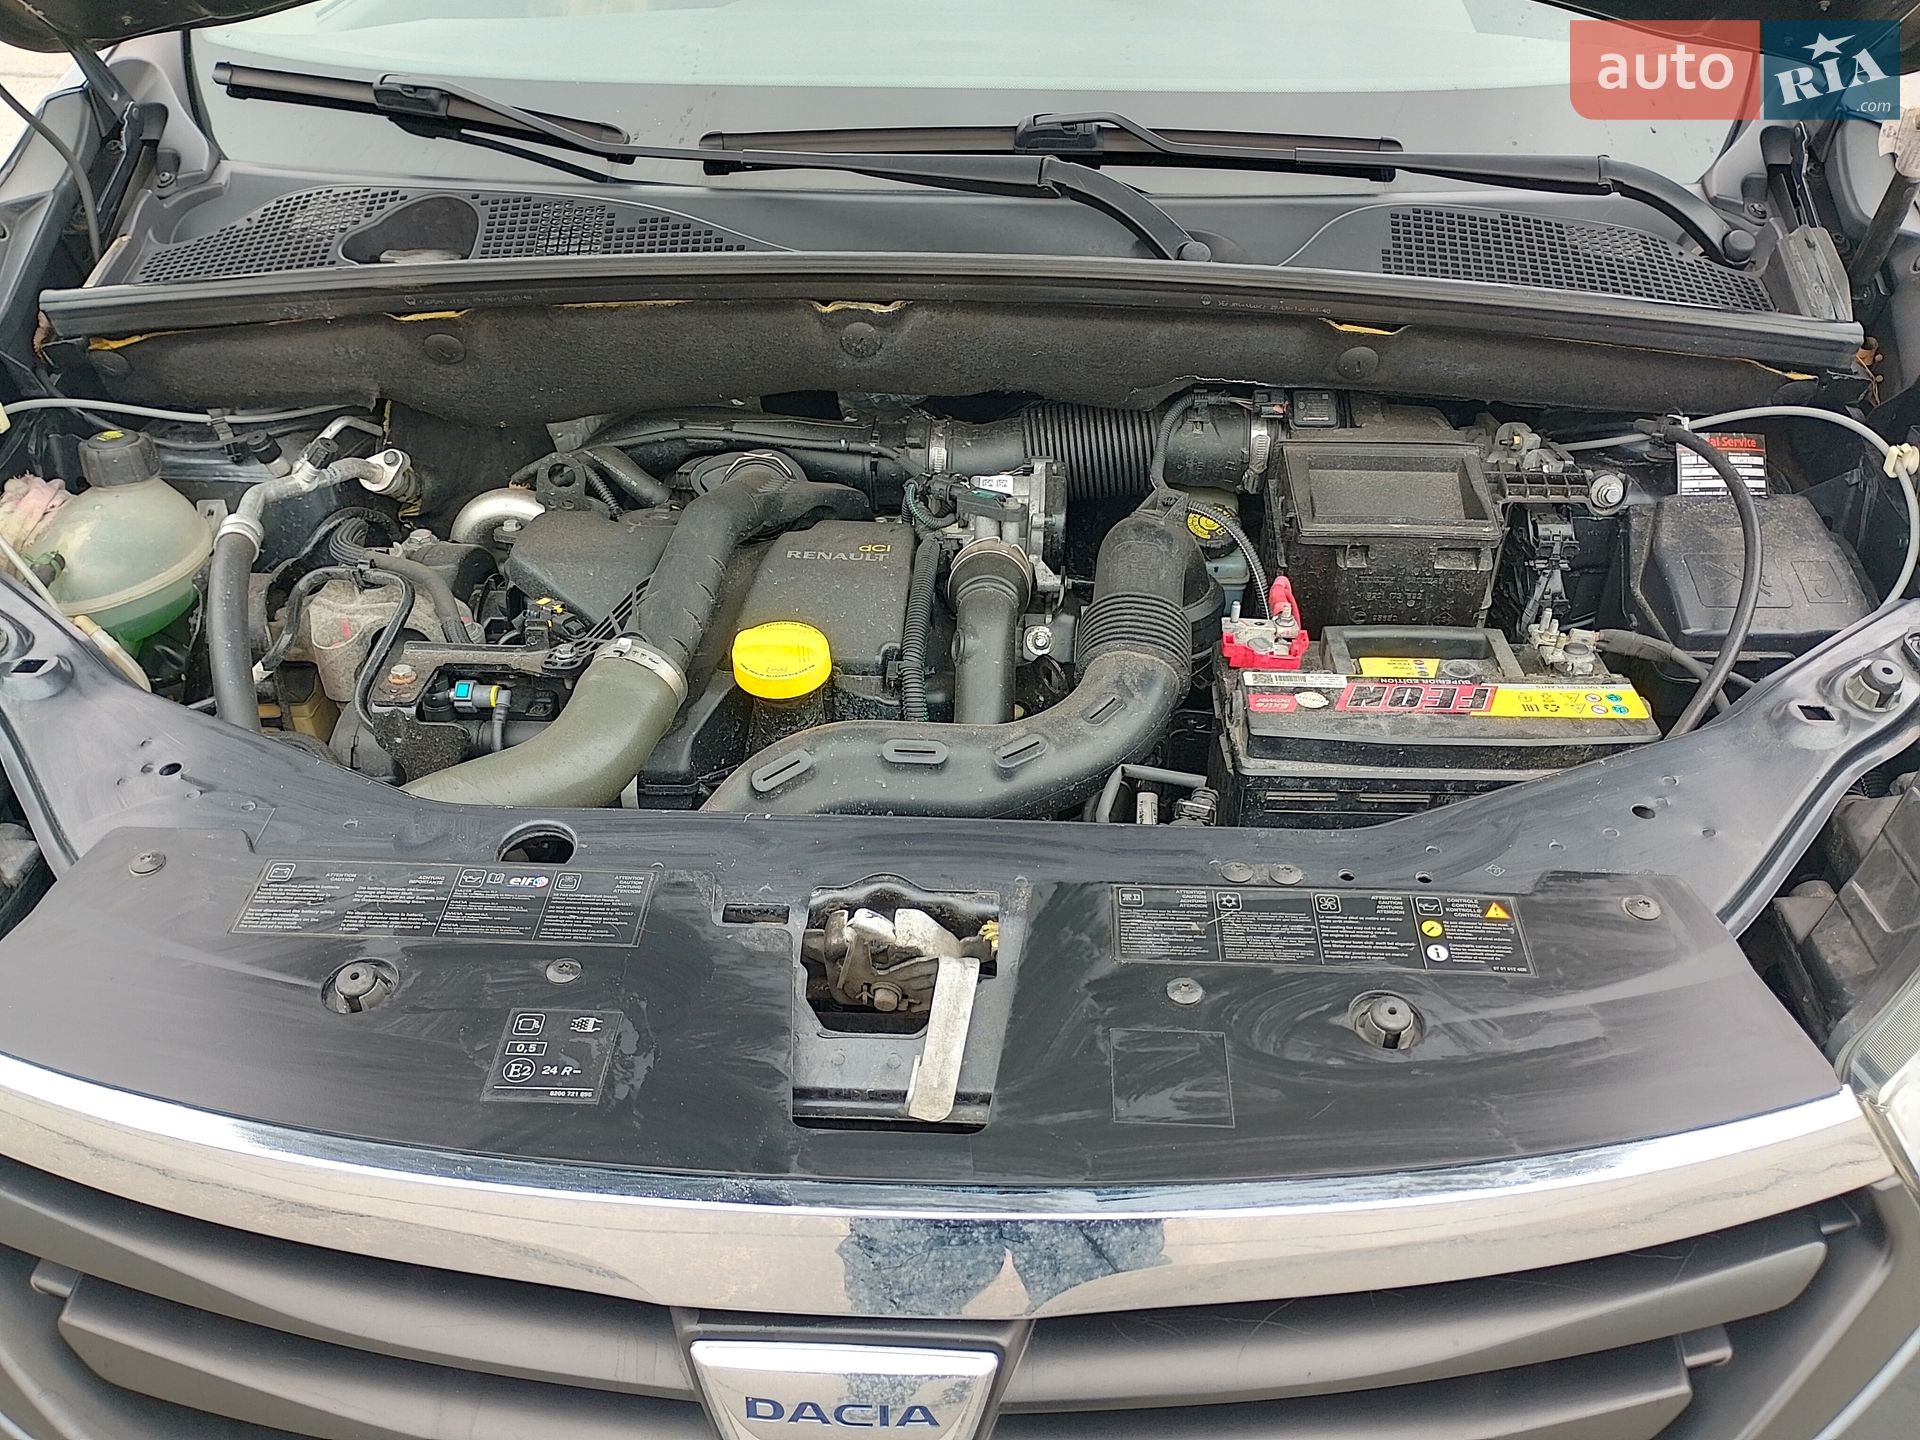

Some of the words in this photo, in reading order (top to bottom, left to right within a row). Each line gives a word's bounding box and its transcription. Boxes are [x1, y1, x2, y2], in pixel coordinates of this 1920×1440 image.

[1721, 436, 1757, 448] Service
[786, 550, 889, 562] RENAULT
[516, 1043, 537, 1054] 0,5
[507, 1063, 531, 1078] E2
[541, 1066, 558, 1075] 24
[745, 1396, 941, 1428] DACIA
